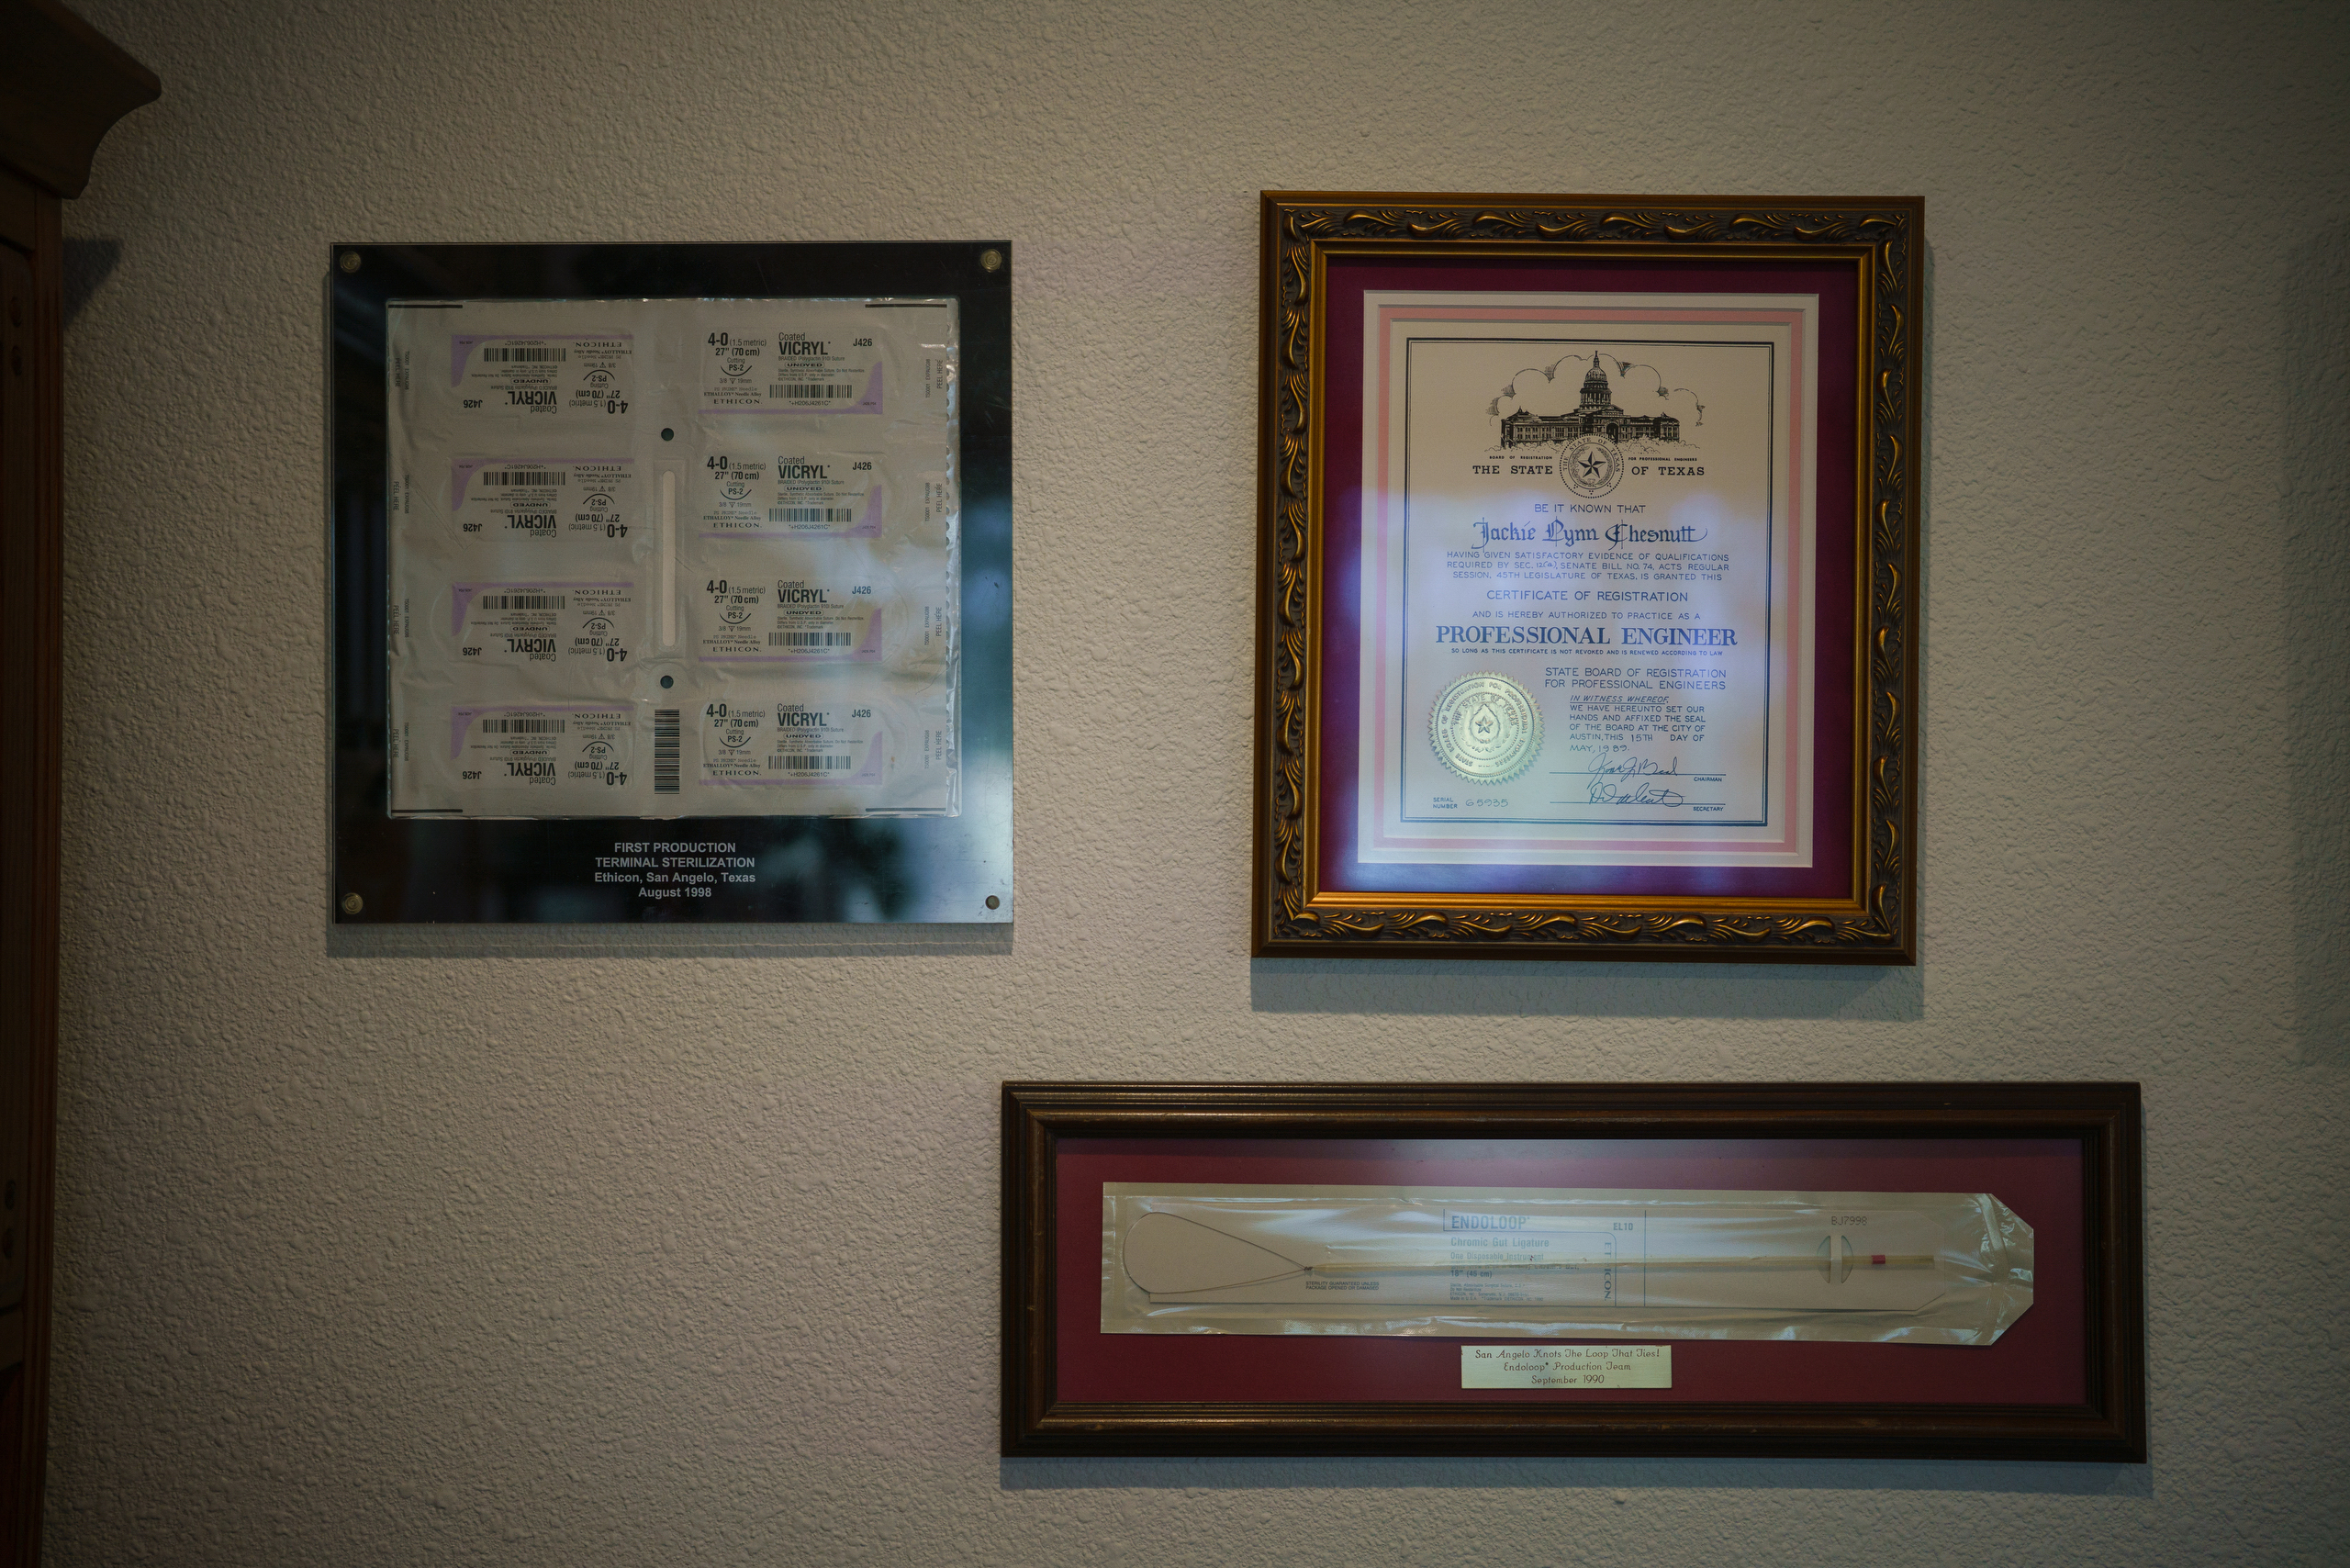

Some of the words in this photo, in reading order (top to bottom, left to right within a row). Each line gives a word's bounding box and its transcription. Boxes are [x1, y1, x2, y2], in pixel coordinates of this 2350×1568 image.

[707, 332, 729, 346] 4-0
[729, 338, 742, 347] (1.5
[744, 338, 767, 347] metric)
[778, 332, 806, 342] Coated
[853, 338, 873, 347] J426
[732, 347, 744, 356] (70
[744, 347, 760, 356] cm)
[726, 356, 745, 364] Cutting
[463, 399, 483, 409] J426
[569, 399, 592, 408] metric)
[608, 400, 629, 413] 4-0
[530, 405, 557, 414] Coated
[706, 456, 728, 470] 4-0
[729, 462, 742, 470] (1.5
[743, 462, 767, 470] metric)
[778, 455, 805, 465] Coated
[852, 462, 872, 470] J426
[1472, 465, 1500, 475] THE
[1510, 465, 1553, 475] STATE
[1631, 466, 1649, 476] OF
[1658, 466, 1705, 476] TEXAS
[1535, 503, 1549, 512] BE
[1554, 503, 1564, 512] IT
[1570, 504, 1612, 513] KNOWN
[1617, 504, 1646, 513] THAT
[463, 523, 483, 532] J426
[568, 523, 592, 532] metric)
[607, 523, 628, 537] 4-0
[530, 529, 557, 538] Coated
[1471, 517, 1536, 552] Jackie
[1542, 516, 1600, 547] Lynn
[1605, 520, 1707, 551] Chesnutt
[1483, 551, 1511, 559] GIVEN
[1515, 551, 1584, 560] SATISFACTORY
[1588, 552, 1634, 560] EVIDENCE
[1654, 553, 1729, 562] QUALIFICATIONS
[705, 579, 727, 593] 4-0
[728, 585, 741, 594] (1.5
[742, 585, 766, 594] metric)
[777, 579, 804, 589] Coated
[852, 586, 872, 595] J426
[1487, 589, 1568, 600] CERTIFICATE
[1574, 590, 1591, 600] OF
[1597, 591, 1688, 602] REGISTRATION
[1507, 610, 1544, 619] HEREBY
[1548, 611, 1607, 620] AUTHORIZED
[1611, 611, 1623, 620] TO
[1627, 611, 1673, 621] PRACTICE
[1678, 612, 1690, 621] AS
[1436, 626, 1610, 644] PROFESSIONAL
[1621, 627, 1738, 646] ENGINEER
[463, 646, 482, 656] J426
[568, 647, 591, 655] metric)
[606, 648, 628, 661] 4-0
[529, 652, 556, 662] Coated
[1545, 666, 1579, 677] STATE
[1584, 667, 1622, 678] BOARD
[1627, 667, 1641, 678] OF
[1646, 668, 1726, 678] REGISTRATION
[1545, 678, 1566, 689] FOR
[1572, 679, 1653, 689] PROFESSIONAL
[1659, 680, 1726, 690] ENGINEERS
[705, 703, 727, 717] 4-0
[728, 709, 741, 718] (1.5
[742, 709, 766, 718] metric)
[777, 703, 804, 712] Coated
[851, 709, 871, 718] J426
[462, 771, 482, 779] J426
[568, 770, 591, 779] metric)
[606, 771, 628, 785] 4-0
[529, 776, 556, 786] Coated
[614, 842, 650, 853] FIRST
[654, 842, 736, 853] PRODUCTION
[595, 857, 659, 868] TERMINAL
[662, 857, 755, 868] STERILIZATION
[595, 872, 643, 884] Ethicon,
[646, 872, 668, 882] San
[672, 872, 718, 885] Angelo,
[721, 872, 756, 882] Texas
[638, 887, 681, 900] August
[685, 887, 712, 898] 1998
[1830, 1215, 1867, 1226] BJ7998
[1613, 1222, 1634, 1231] EL10
[1449, 1237, 1489, 1247] Chromic
[1492, 1237, 1507, 1248] Gut
[1512, 1238, 1550, 1249] Ligature
[1467, 1252, 1504, 1260] Disposable
[1480, 1271, 1493, 1279] cm)
[1474, 1350, 1493, 1359] San
[1495, 1350, 1530, 1361] Angelo
[1533, 1349, 1561, 1358] Knots
[1564, 1348, 1583, 1358] The
[1585, 1348, 1608, 1360] Loop
[1611, 1348, 1633, 1358] That
[1636, 1348, 1660, 1358] Ties!
[1552, 1361, 1603, 1371] Production
[1606, 1361, 1631, 1371] Team
[1531, 1374, 1577, 1386] September
[1583, 1374, 1605, 1384] 1990
